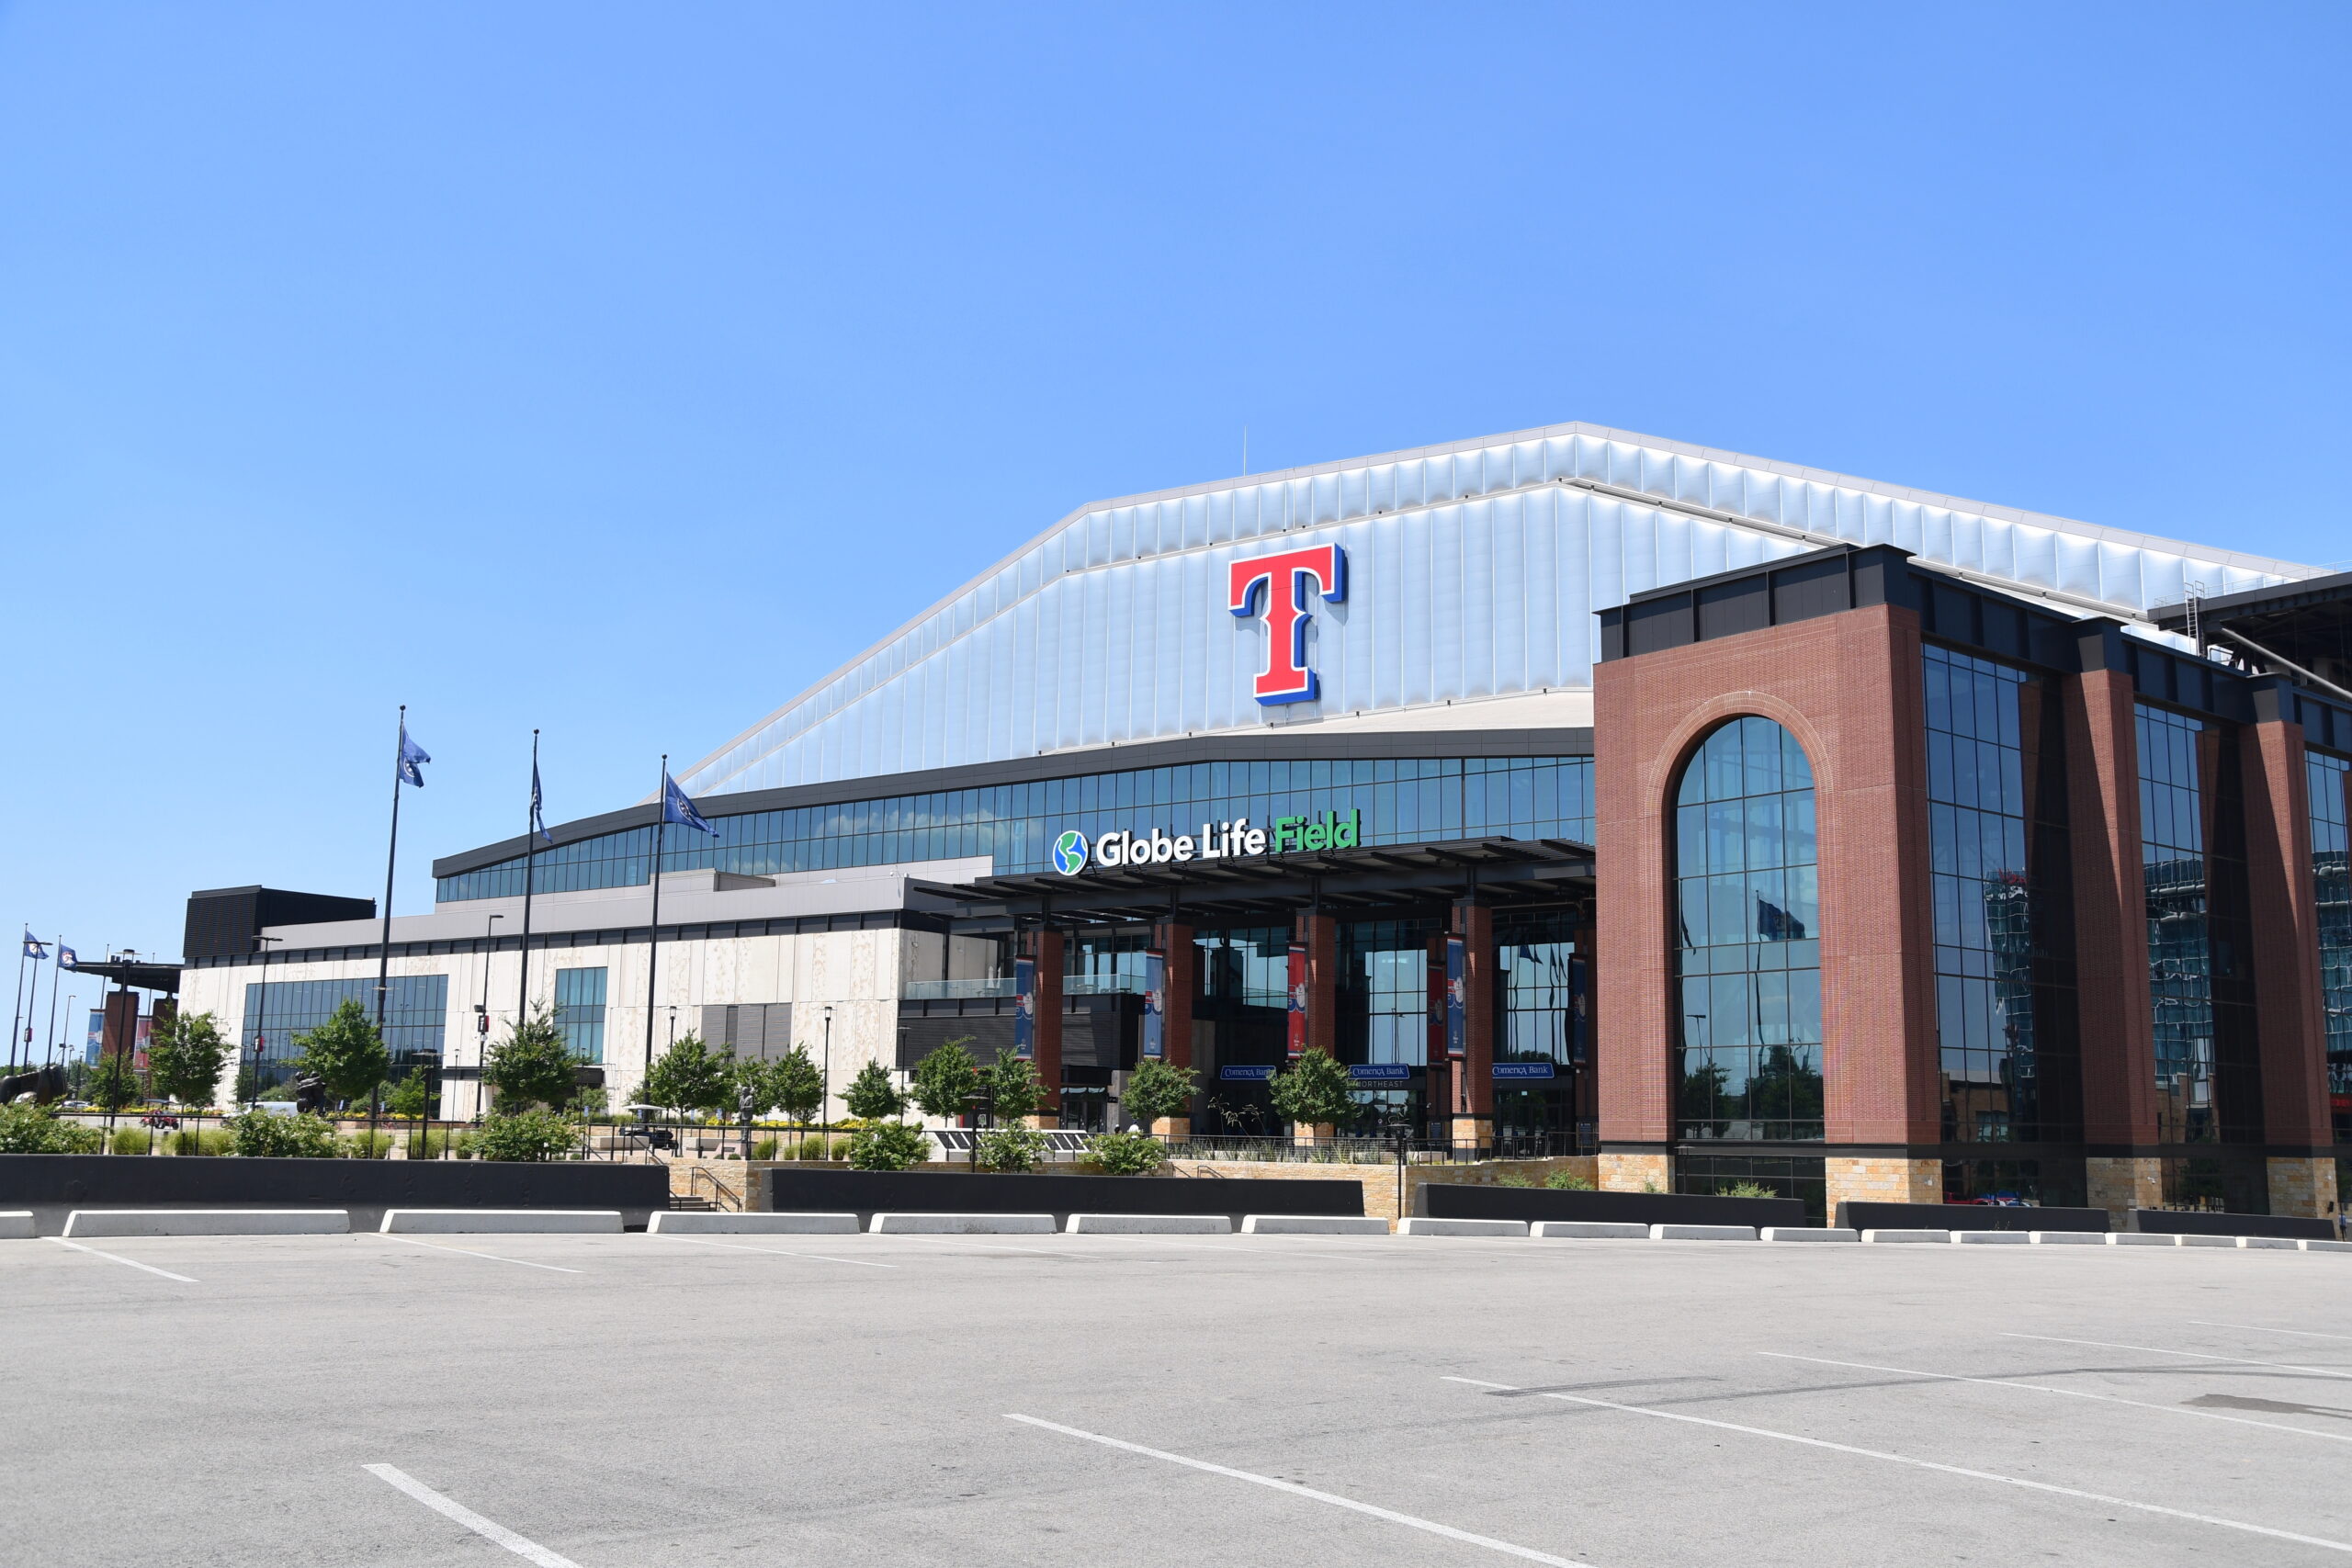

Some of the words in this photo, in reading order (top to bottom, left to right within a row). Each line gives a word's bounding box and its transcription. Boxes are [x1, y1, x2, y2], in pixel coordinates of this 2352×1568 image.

[1227, 542, 1345, 706] T
[1096, 829, 1193, 867] Globe
[1203, 818, 1266, 859] Life
[1275, 808, 1360, 852] Field
